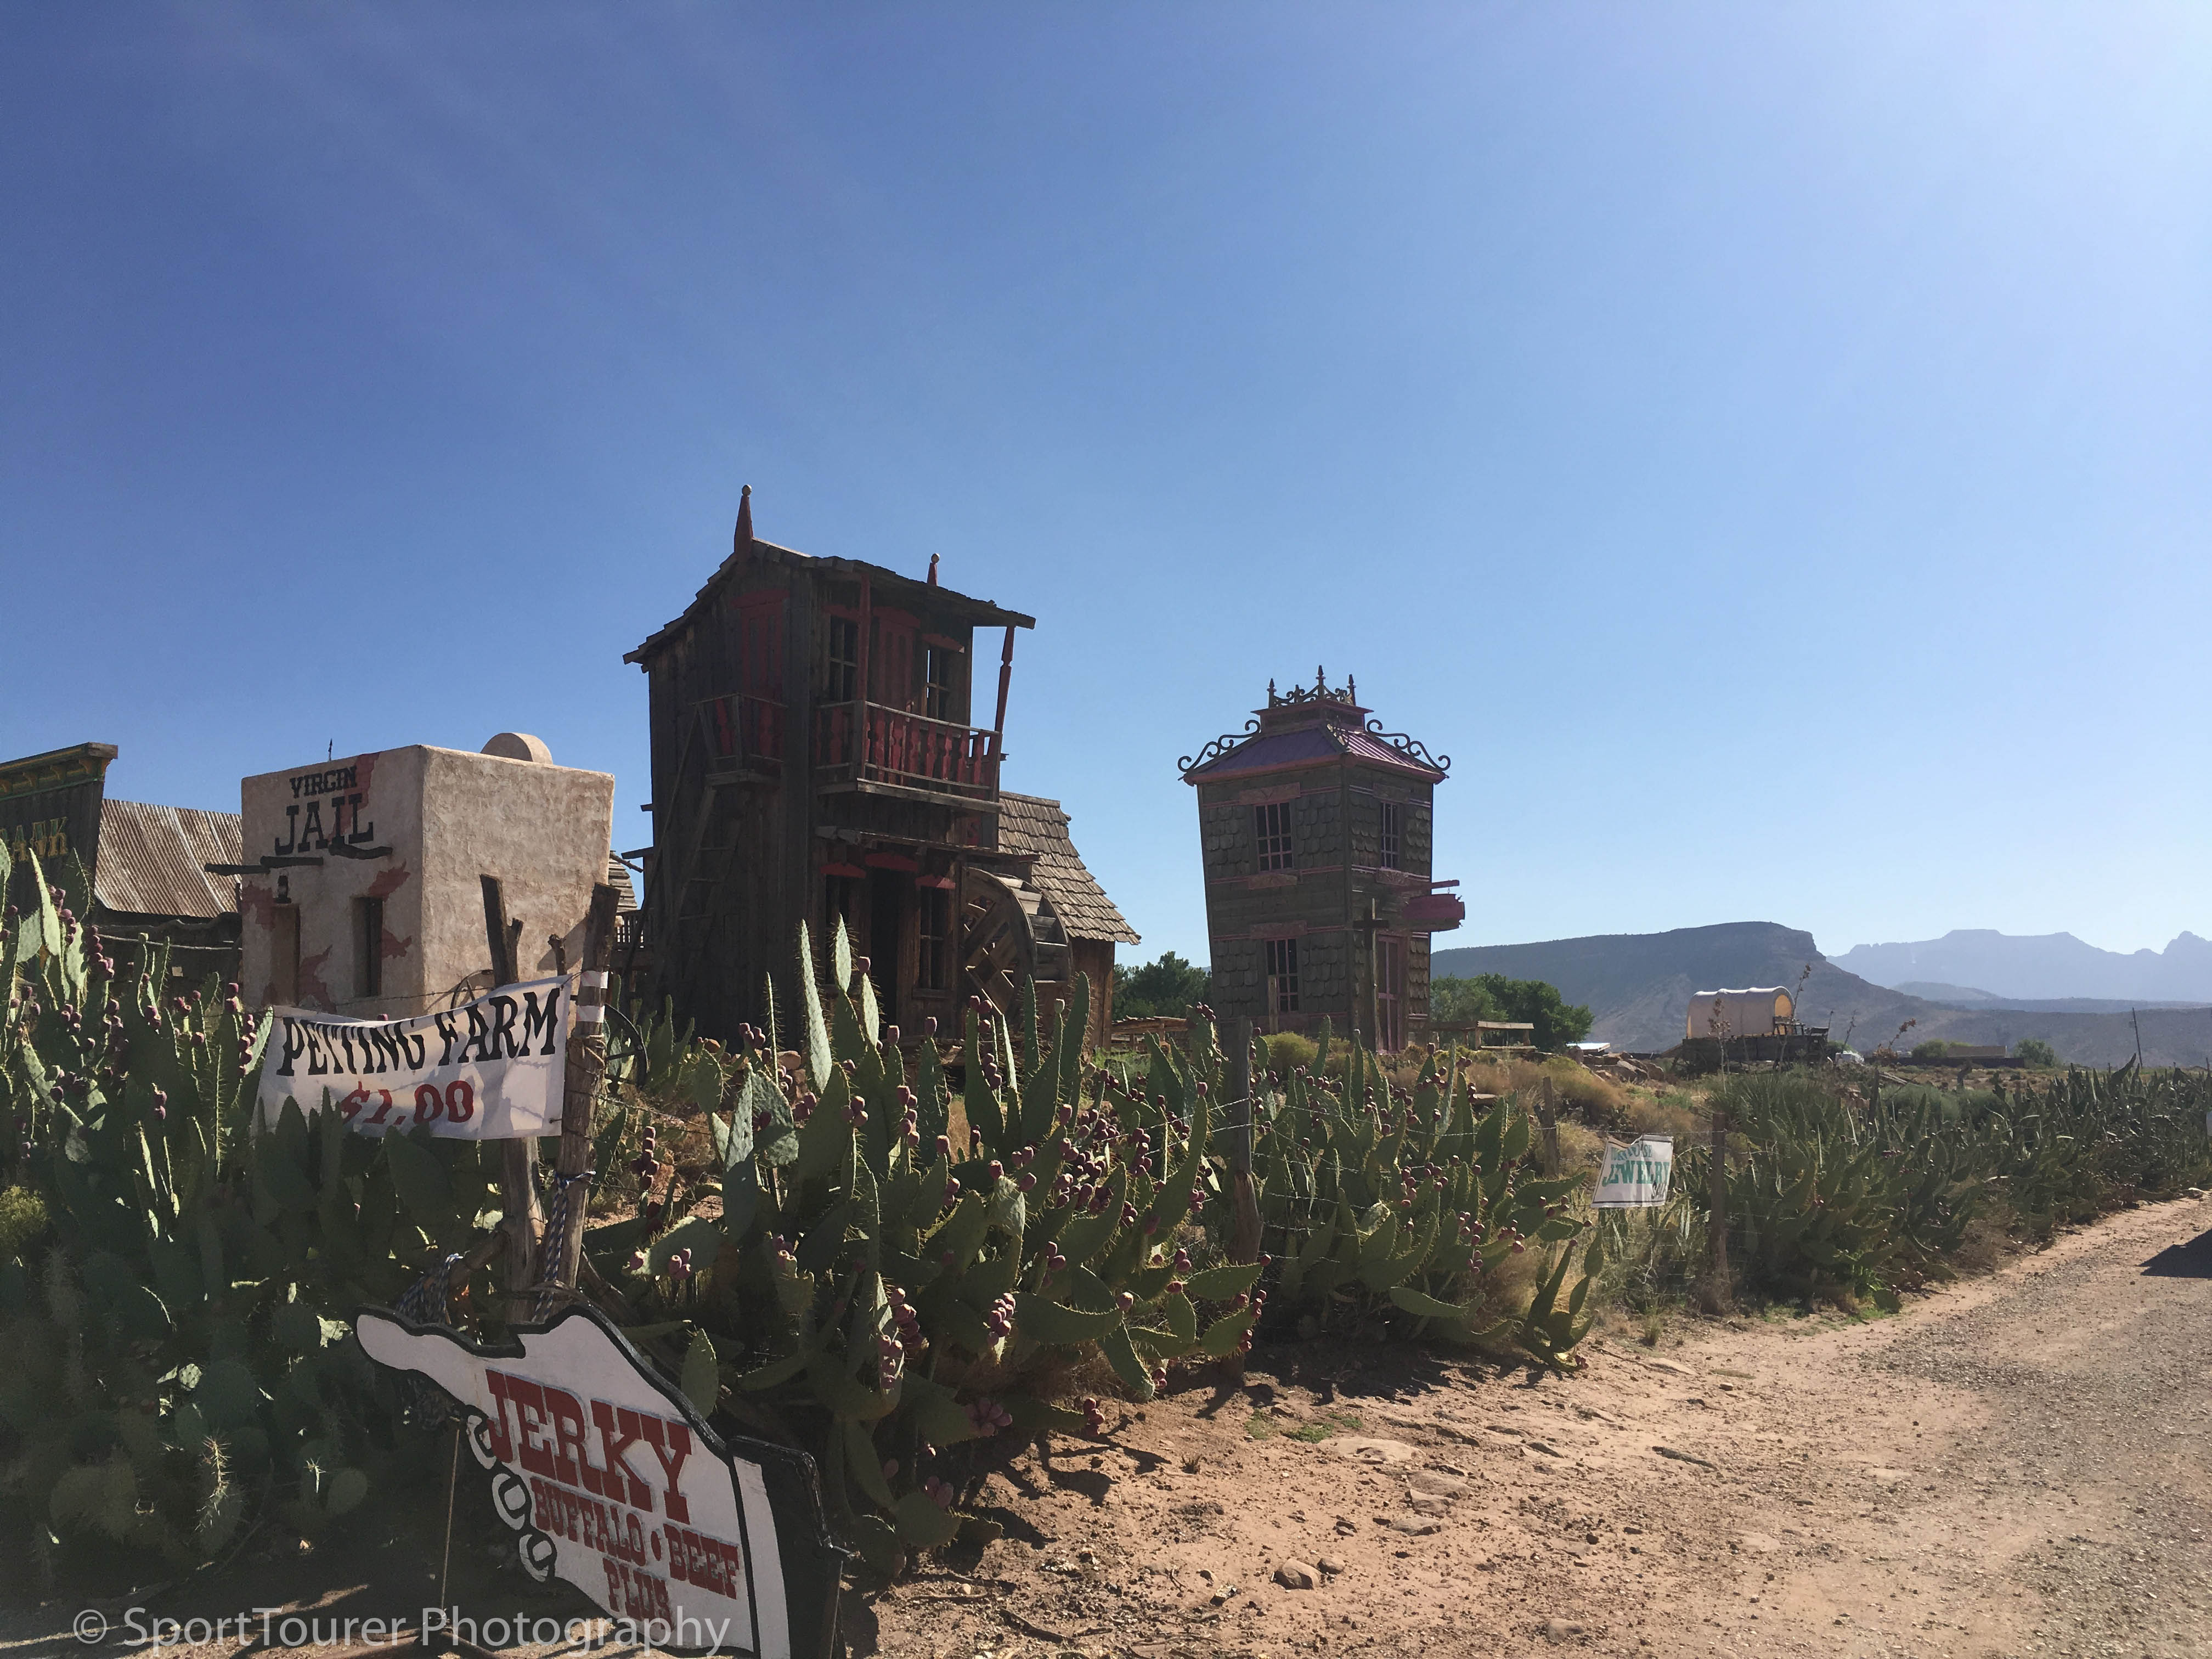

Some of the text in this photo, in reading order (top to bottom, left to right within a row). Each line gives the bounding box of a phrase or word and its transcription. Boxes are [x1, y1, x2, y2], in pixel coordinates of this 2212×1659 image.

[290, 766, 357, 798] VIRGIN
[0, 816, 69, 863] ANK
[275, 793, 374, 855] JAIL
[276, 988, 560, 1076] PETTING FARM
[486, 1369, 693, 1525] JERKY
[529, 1477, 740, 1600] BUFFALO BEEF
[602, 1558, 674, 1632] PLUS
